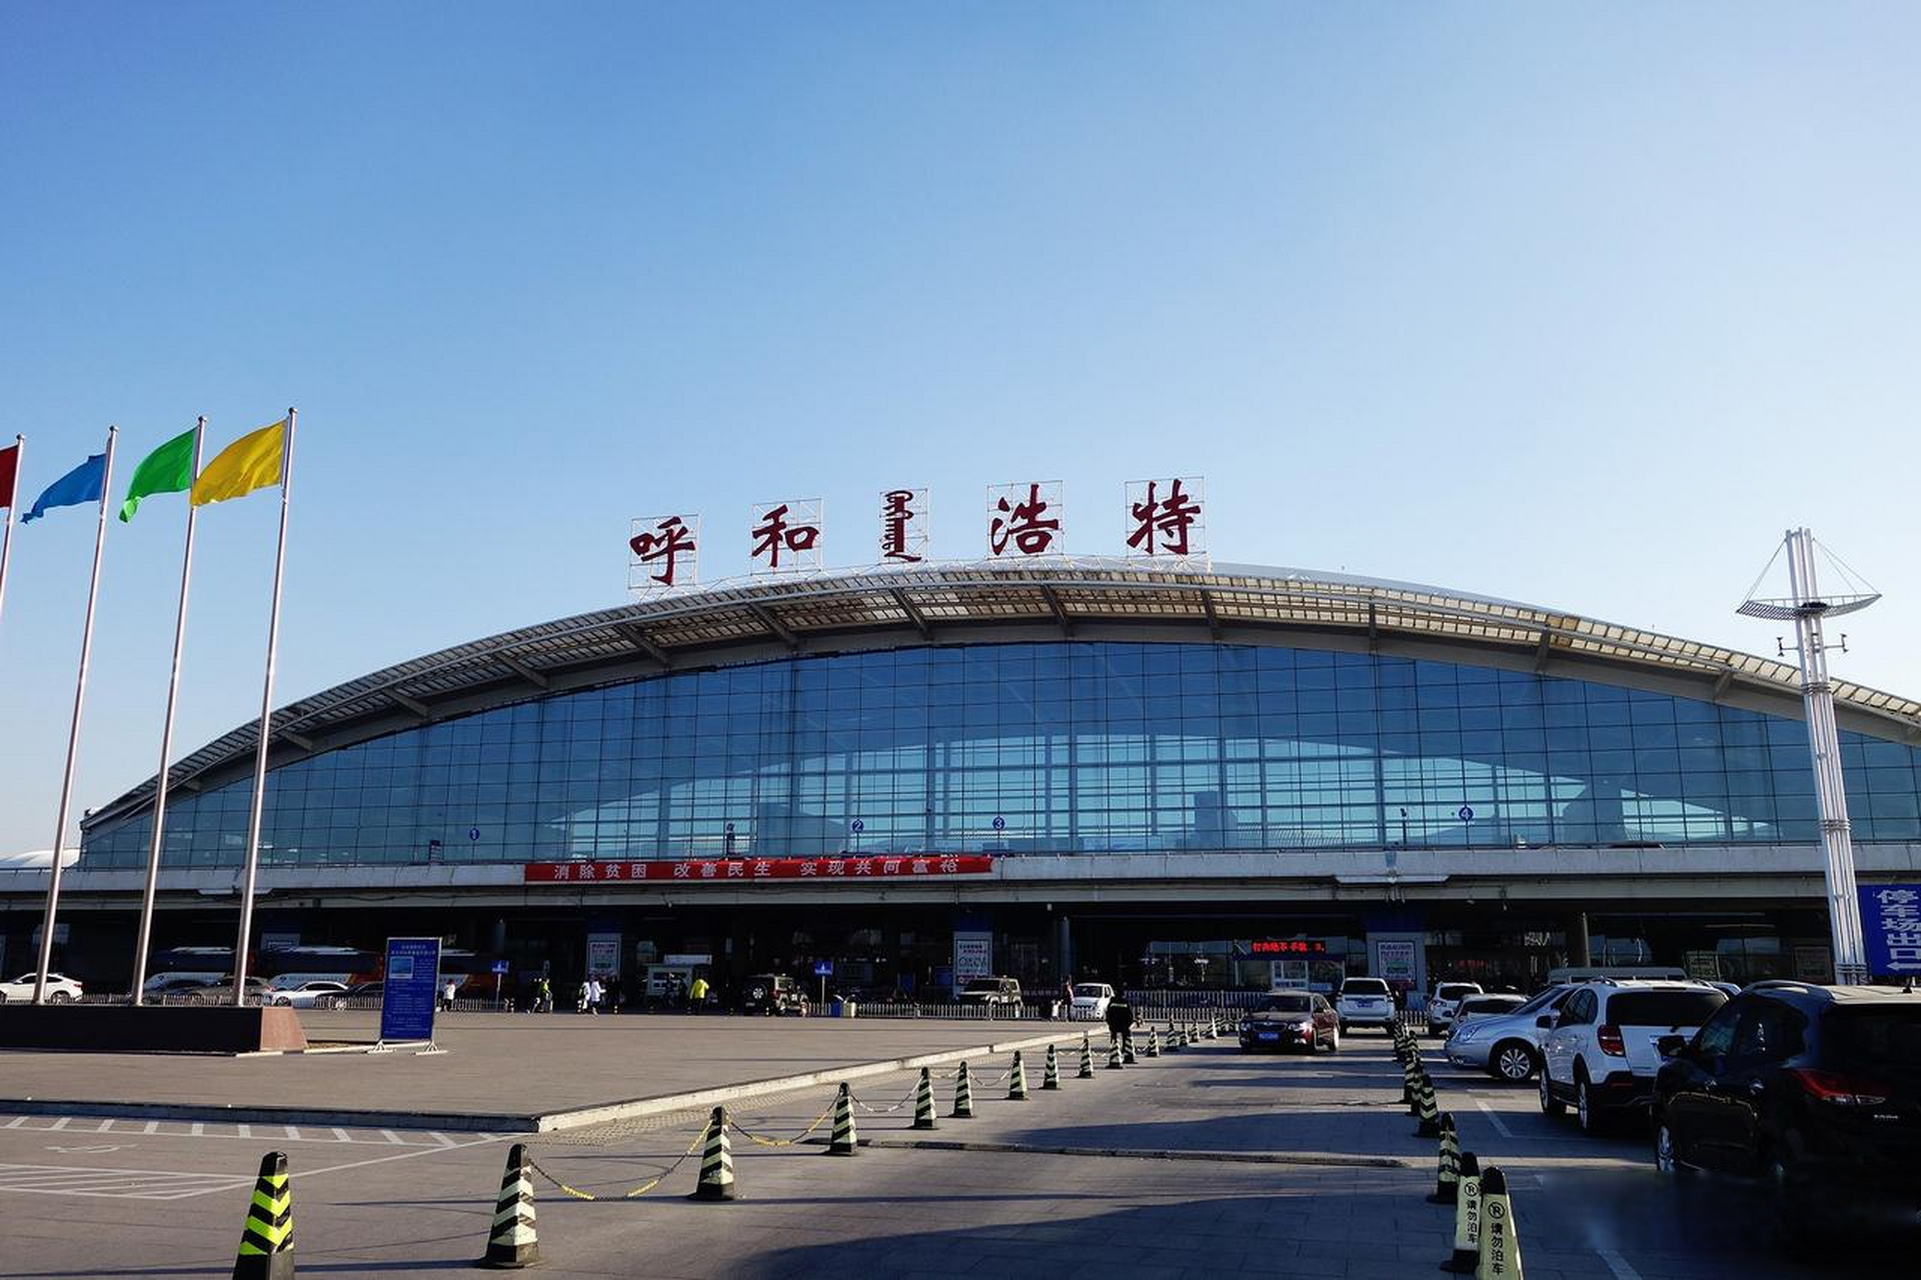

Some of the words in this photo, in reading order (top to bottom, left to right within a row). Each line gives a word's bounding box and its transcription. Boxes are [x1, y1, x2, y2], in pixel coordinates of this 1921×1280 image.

[554, 863, 647, 879] 消除贫困
[673, 862, 771, 878] 改善民生
[1876, 889, 1921, 960] 停车场出口
[1466, 1200, 1478, 1244] 请勿泊车
[1491, 1222, 1504, 1275] 请勿泊车
